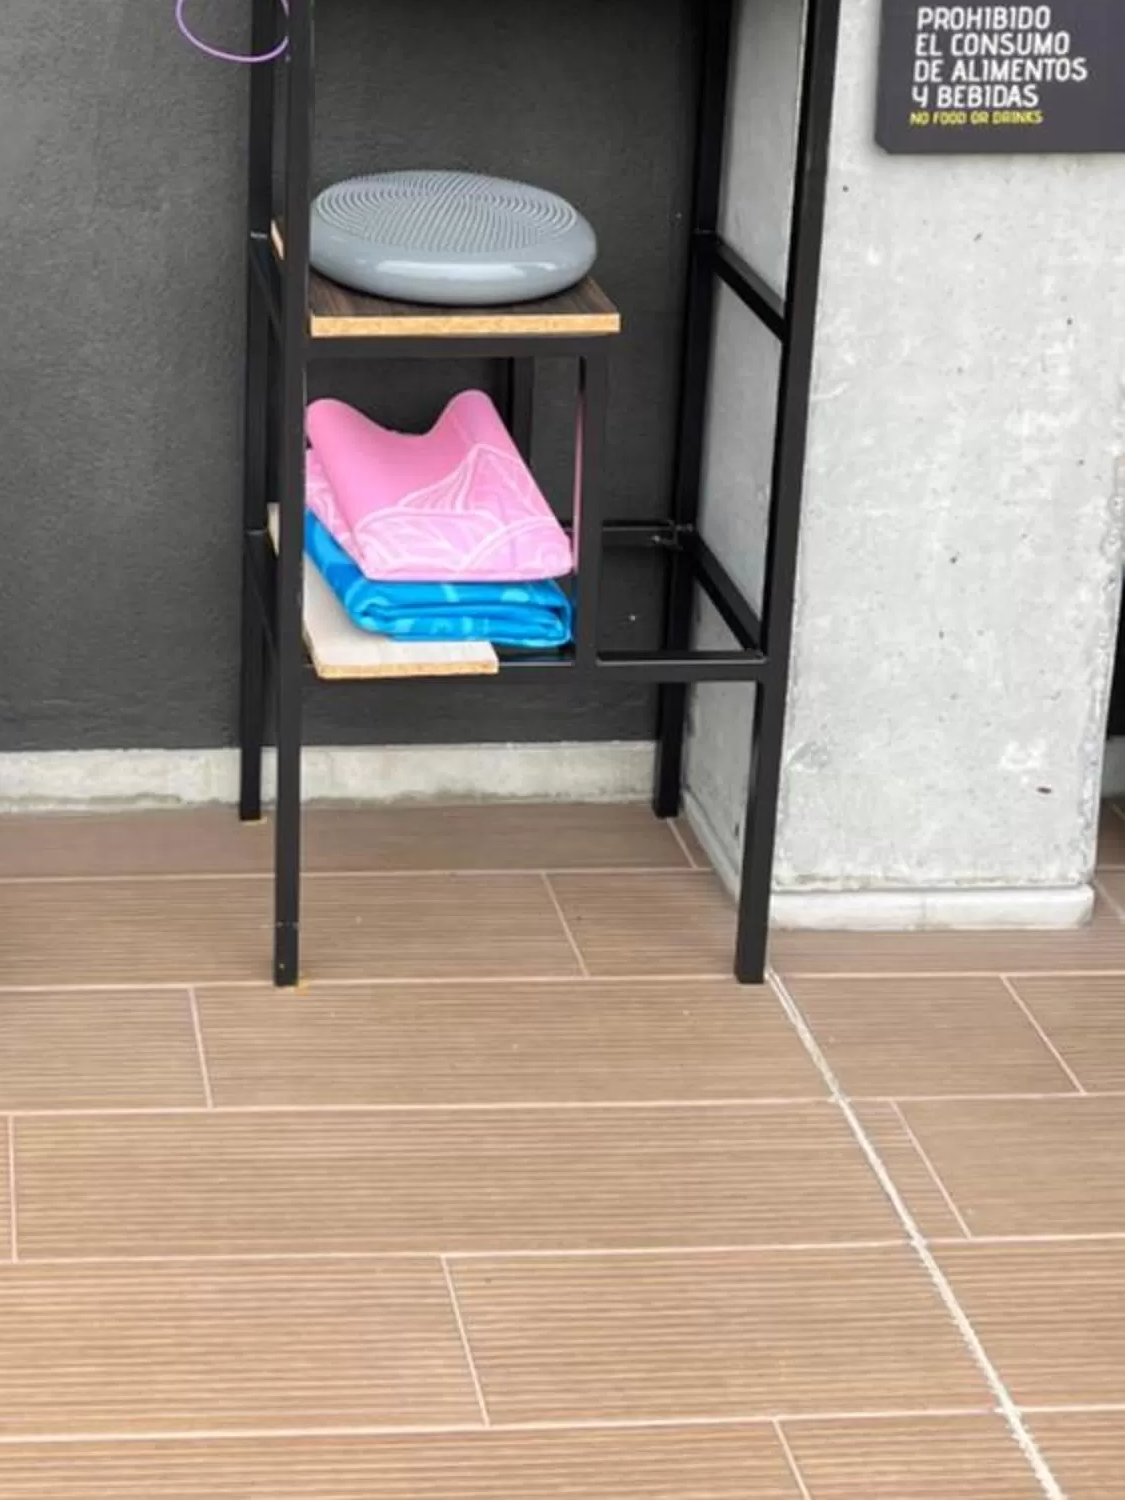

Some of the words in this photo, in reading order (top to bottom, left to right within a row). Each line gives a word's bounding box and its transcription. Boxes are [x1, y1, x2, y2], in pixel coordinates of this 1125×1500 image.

[917, 5, 1051, 31] PROHIBIDO
[915, 33, 943, 57] EL
[950, 31, 1070, 57] CONSUMO
[914, 59, 944, 83] DE
[951, 57, 1088, 82] ALIMENTOS
[936, 84, 1040, 108] BEBIDAS
[909, 111, 931, 126] NO
[932, 111, 968, 125] FOOD
[970, 111, 990, 125] OR
[992, 110, 1043, 125] DRINKS
